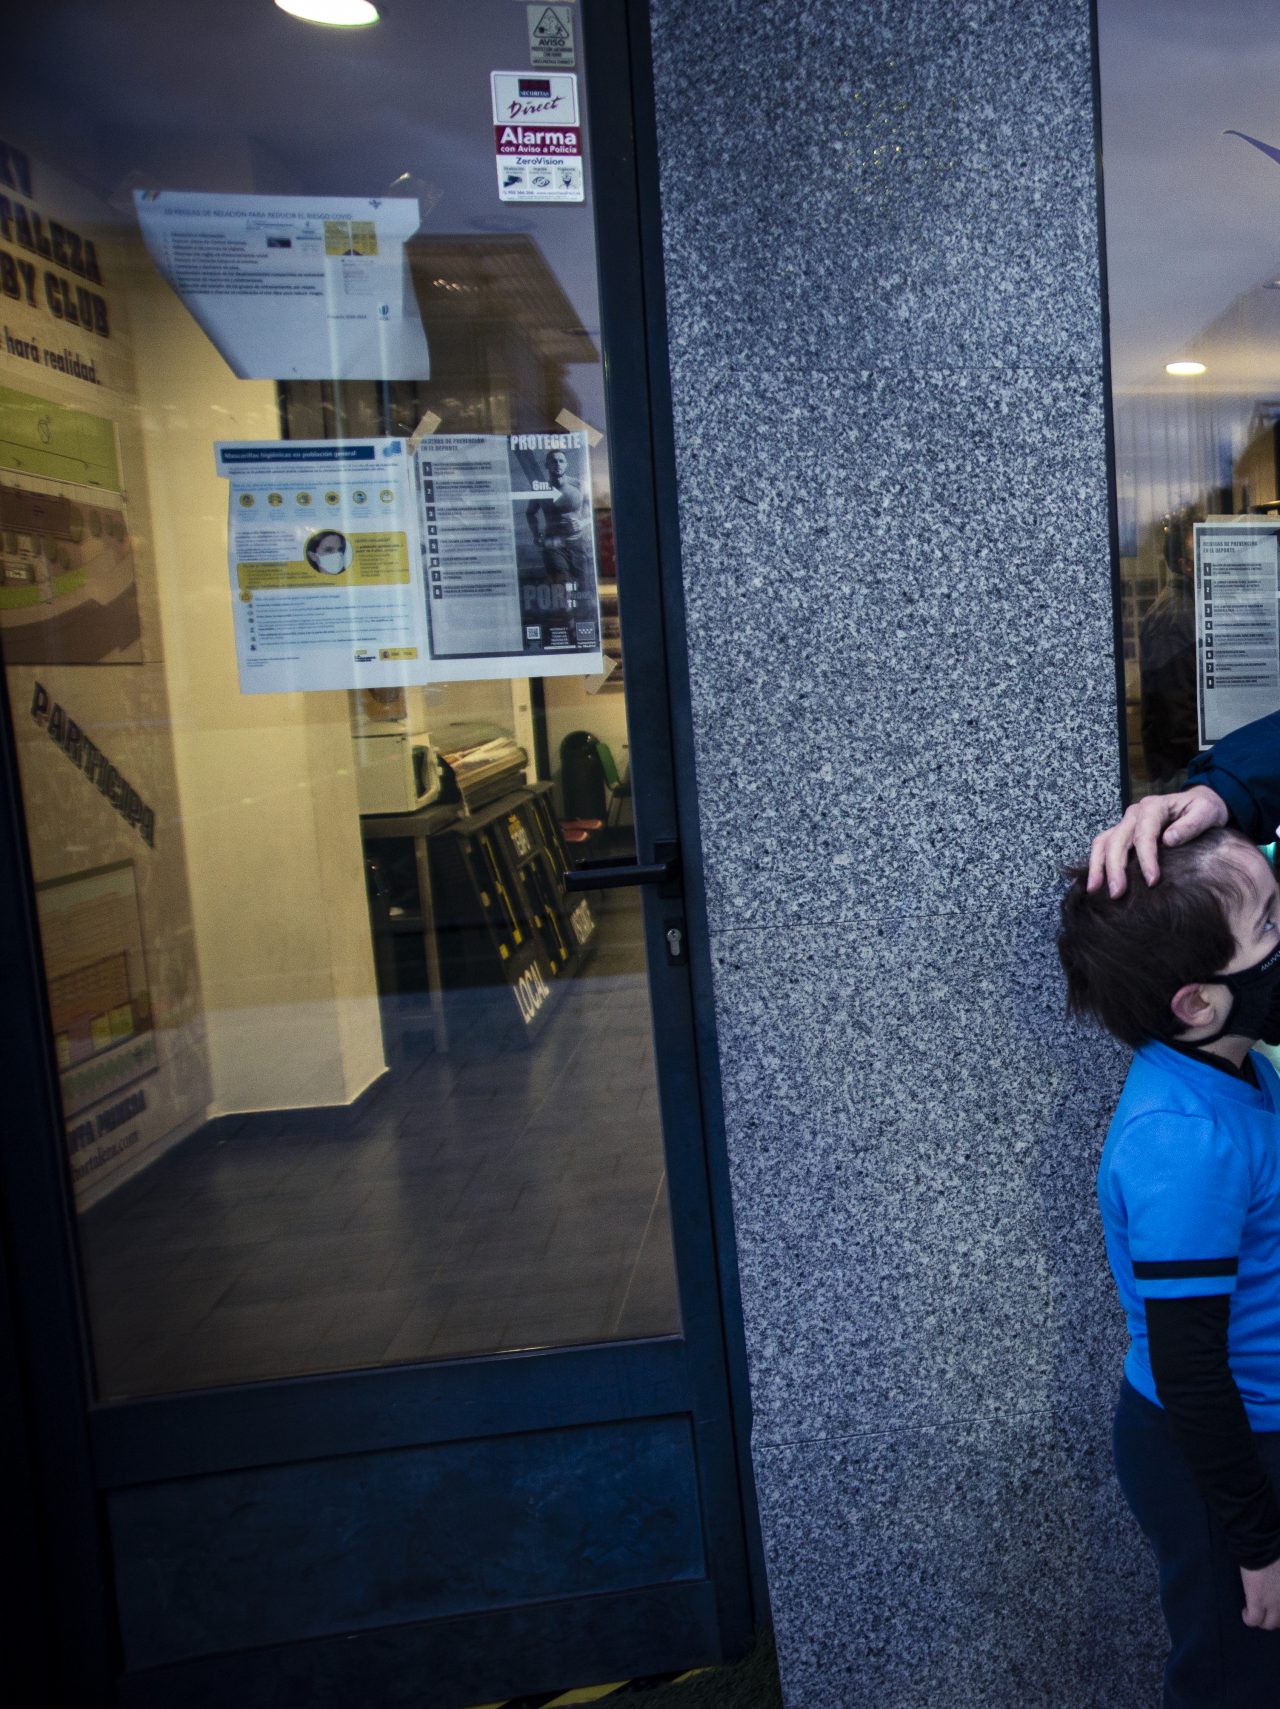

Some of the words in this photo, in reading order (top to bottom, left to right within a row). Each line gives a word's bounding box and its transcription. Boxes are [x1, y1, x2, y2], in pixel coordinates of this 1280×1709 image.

[539, 39, 565, 47] AVISO
[507, 96, 565, 119] Direct
[500, 126, 577, 145] Alarma
[517, 145, 541, 153] Aviso
[516, 157, 564, 166] ZeroVision
[44, 270, 109, 338] CLUB
[4, 324, 40, 364] hará
[44, 349, 101, 385] realidad.
[224, 451, 259, 459] Mascarillas
[302, 450, 333, 459] población
[334, 450, 357, 459] general
[532, 480, 552, 491] 6m.
[513, 959, 551, 1025] LOCAL
